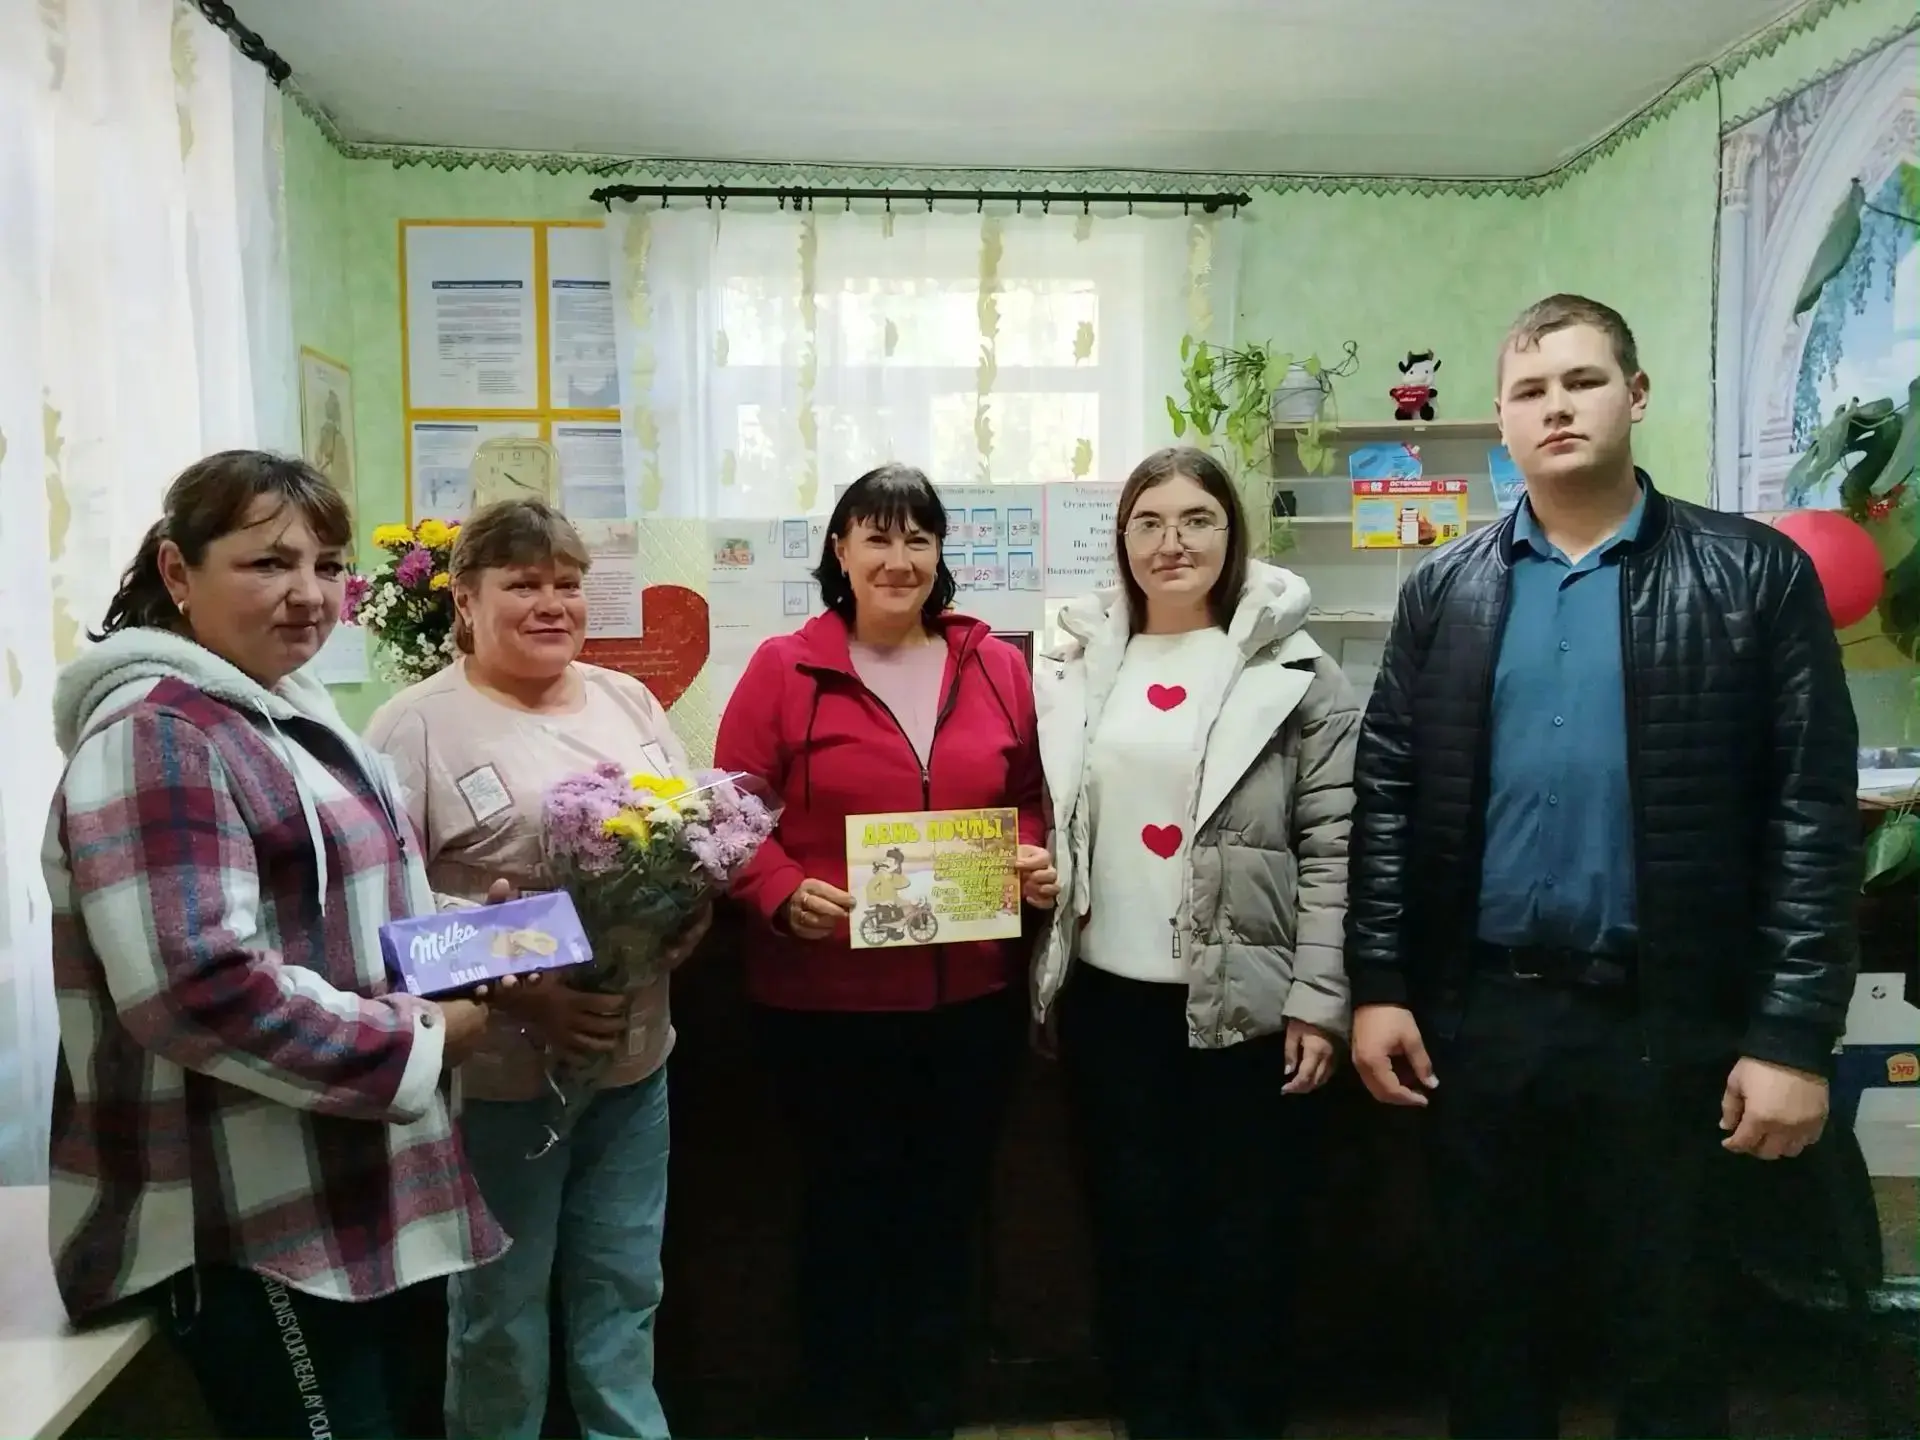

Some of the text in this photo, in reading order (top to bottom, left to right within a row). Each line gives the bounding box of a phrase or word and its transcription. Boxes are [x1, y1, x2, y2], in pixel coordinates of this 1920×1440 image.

[862, 818, 1004, 848] ДЕНЬ ПОЧТЫ
[409, 921, 479, 965] Milka
